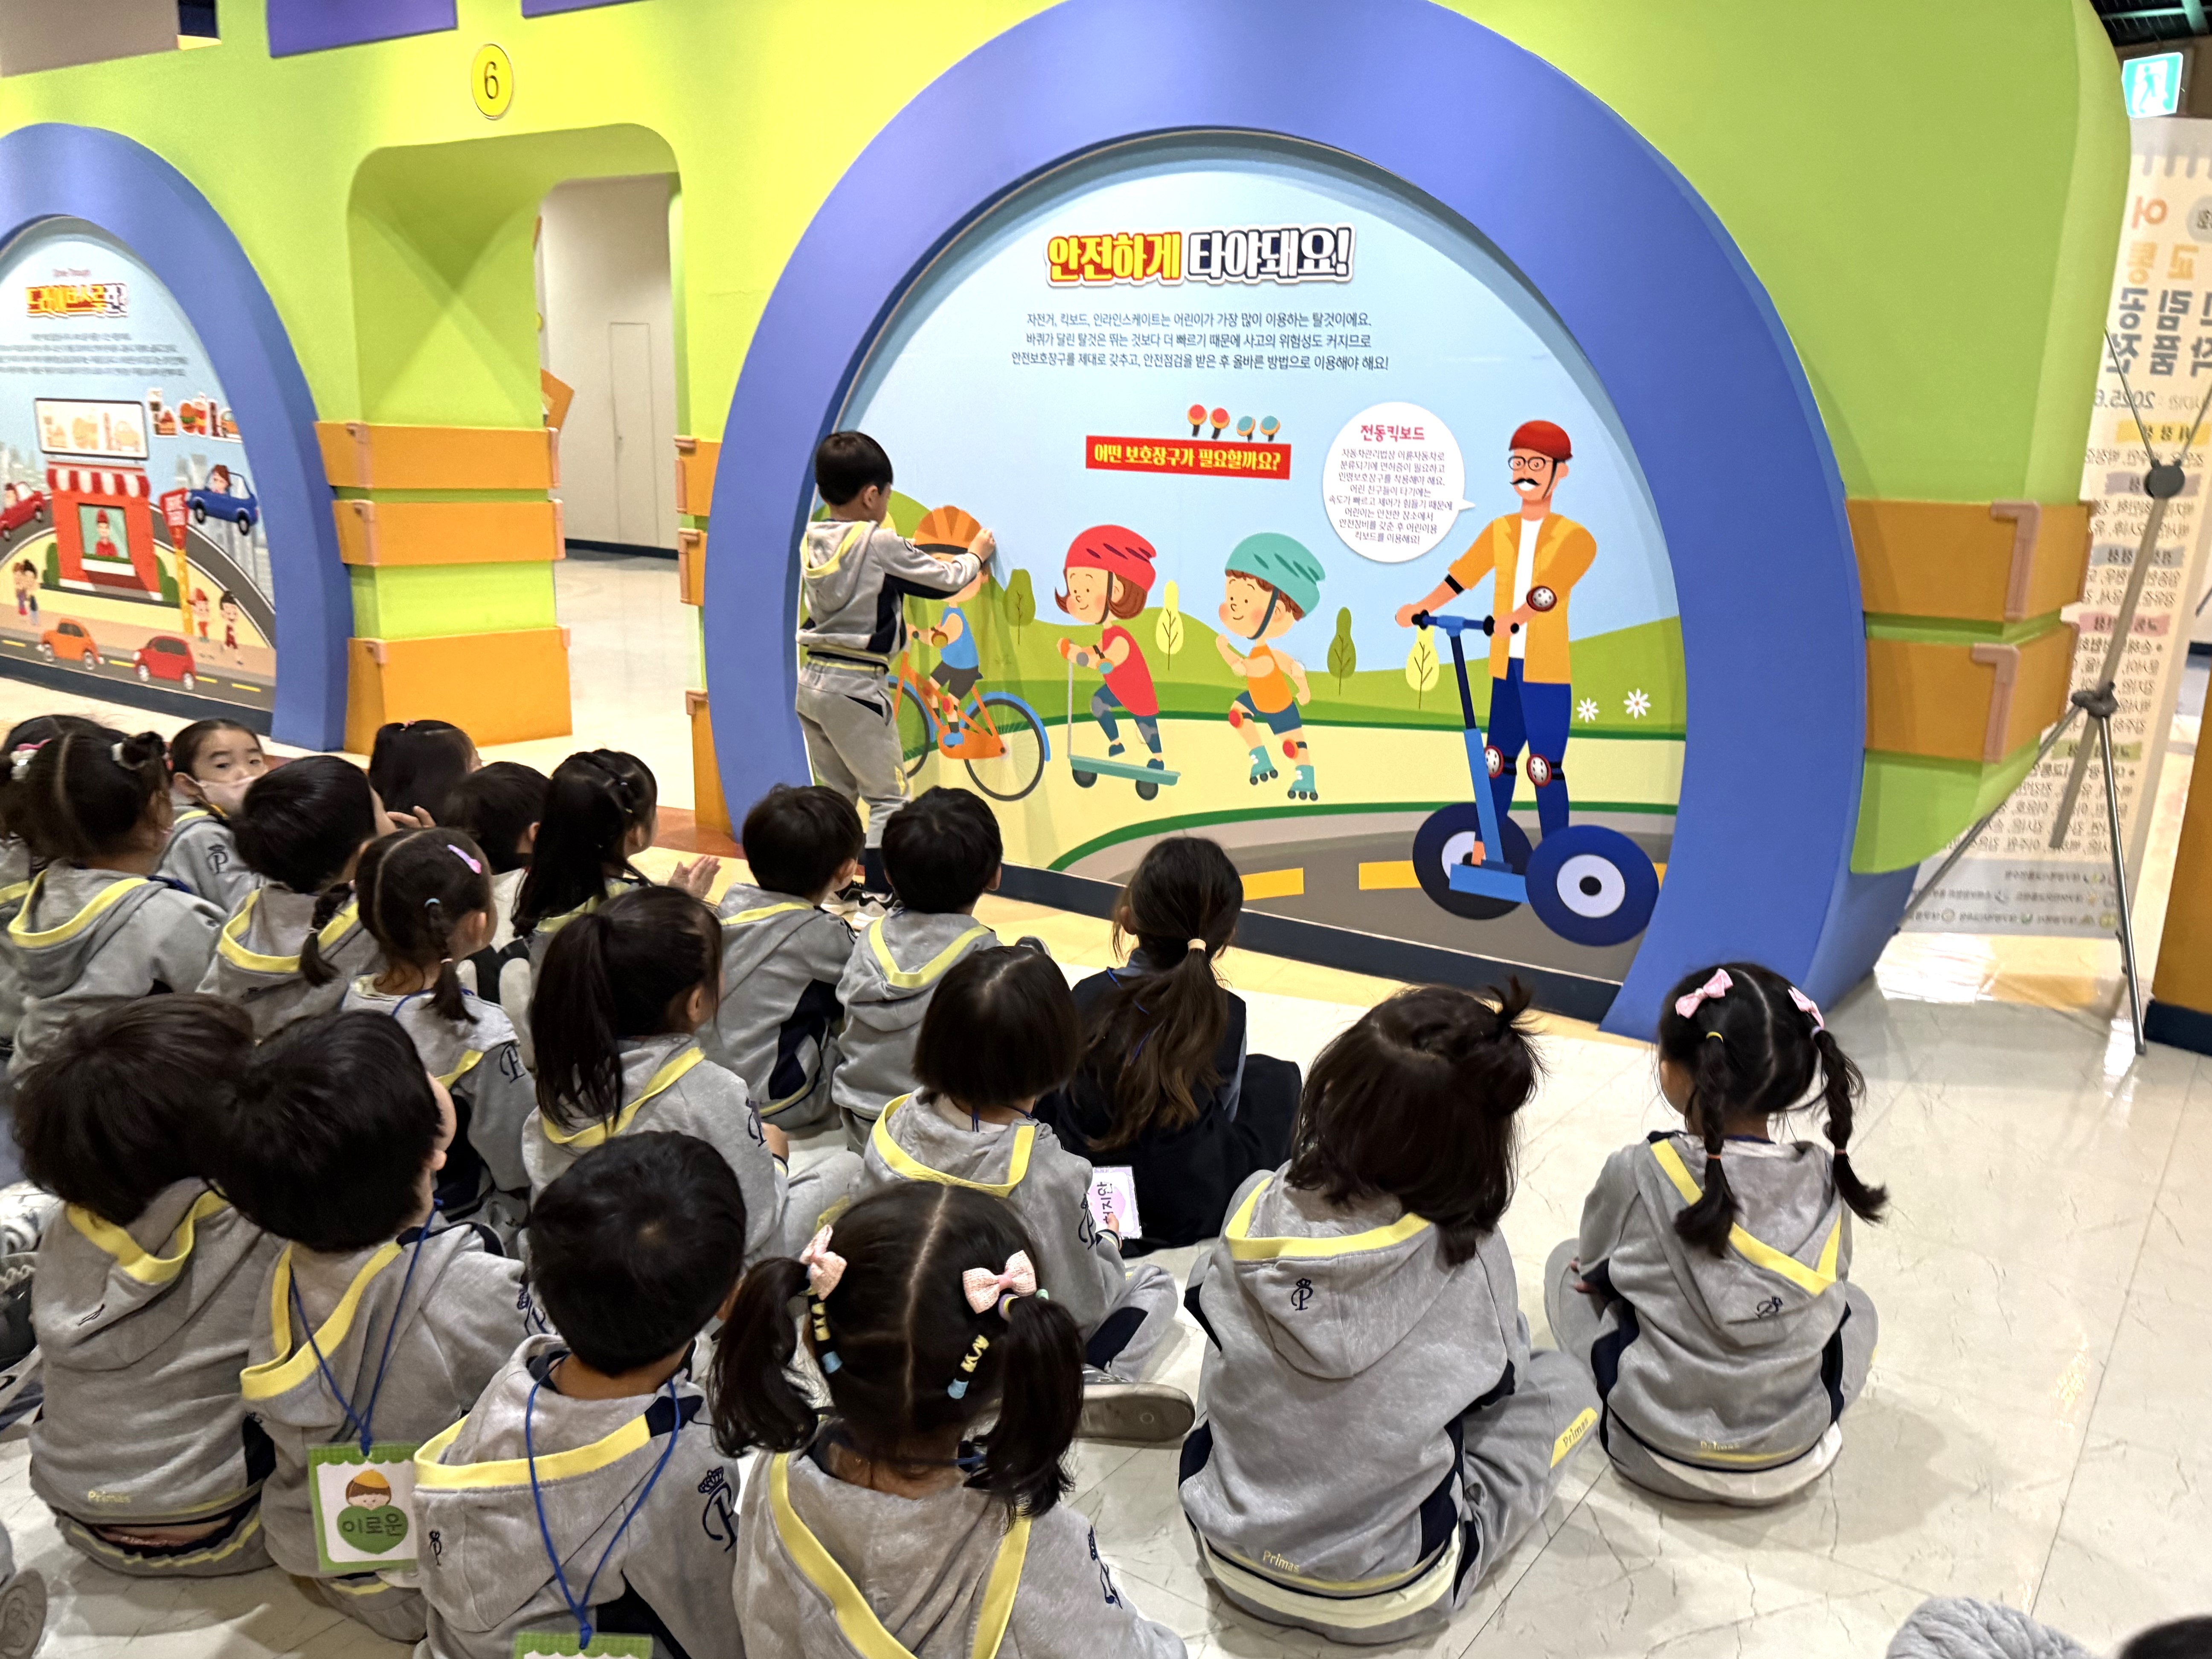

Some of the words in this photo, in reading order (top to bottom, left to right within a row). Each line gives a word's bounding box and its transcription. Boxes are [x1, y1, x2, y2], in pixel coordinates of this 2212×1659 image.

[484, 61, 499, 100] 6
[1048, 232, 1182, 281] 안전하게
[1188, 227, 1351, 278] 타야돼요!
[1027, 313, 1057, 327] 자전거,
[1061, 313, 1090, 327] 킥보드,
[1093, 313, 1170, 327] 인라인스케이트는
[1174, 313, 1213, 327] 어린이가
[1217, 313, 1238, 328] 가장
[1242, 313, 1262, 328] 많이
[1266, 313, 1309, 328] 이용하는
[1313, 312, 1372, 328] 탈것이에요.
[1026, 333, 1054, 346] 바퀴가
[1056, 333, 1074, 346] 달린
[1078, 333, 1106, 347] 탈것은
[1109, 333, 1129, 347] 뛰는
[1132, 333, 1160, 347] 것보다
[1164, 334, 1173, 347] 더
[1176, 334, 1206, 348] 빠르기
[1210, 334, 1240, 348] 때문에
[1244, 334, 1275, 348] 사고의
[1279, 334, 1323, 349] 위험성도
[1326, 334, 1371, 349] 커지므로
[1012, 352, 1074, 366] 안전보호장구를
[1078, 352, 1106, 367] 제대로
[1109, 353, 1140, 368] 갖추고,
[1144, 353, 1192, 368] 안전점검을
[1196, 354, 1216, 368] 받은
[1219, 354, 1230, 368] 후
[1233, 354, 1264, 369] 올바른
[1268, 354, 1311, 370] 방법으로
[1315, 355, 1359, 371] 이용해야
[1362, 355, 1388, 371] 해요!
[1361, 424, 1425, 443] 전동킥보드
[1094, 444, 1122, 463] 어떤
[1125, 445, 1194, 467] 보호장구가
[1199, 448, 1281, 471] 필요할까요?
[1350, 484, 1365, 494] 어린
[1367, 485, 1397, 496] 친구들이
[1400, 486, 1431, 498] 타기에는
[1353, 496, 1376, 506] 빠르고
[1429, 500, 1453, 511] 때문에
[1345, 507, 1374, 518] 어린이는
[1377, 508, 1400, 519] 안전한
[1402, 510, 1434, 522] 장소에서
[1339, 519, 1376, 530] 안전장비를
[342, 1513, 404, 1537] 이로운
[1262, 1549, 1300, 1574] Primas
